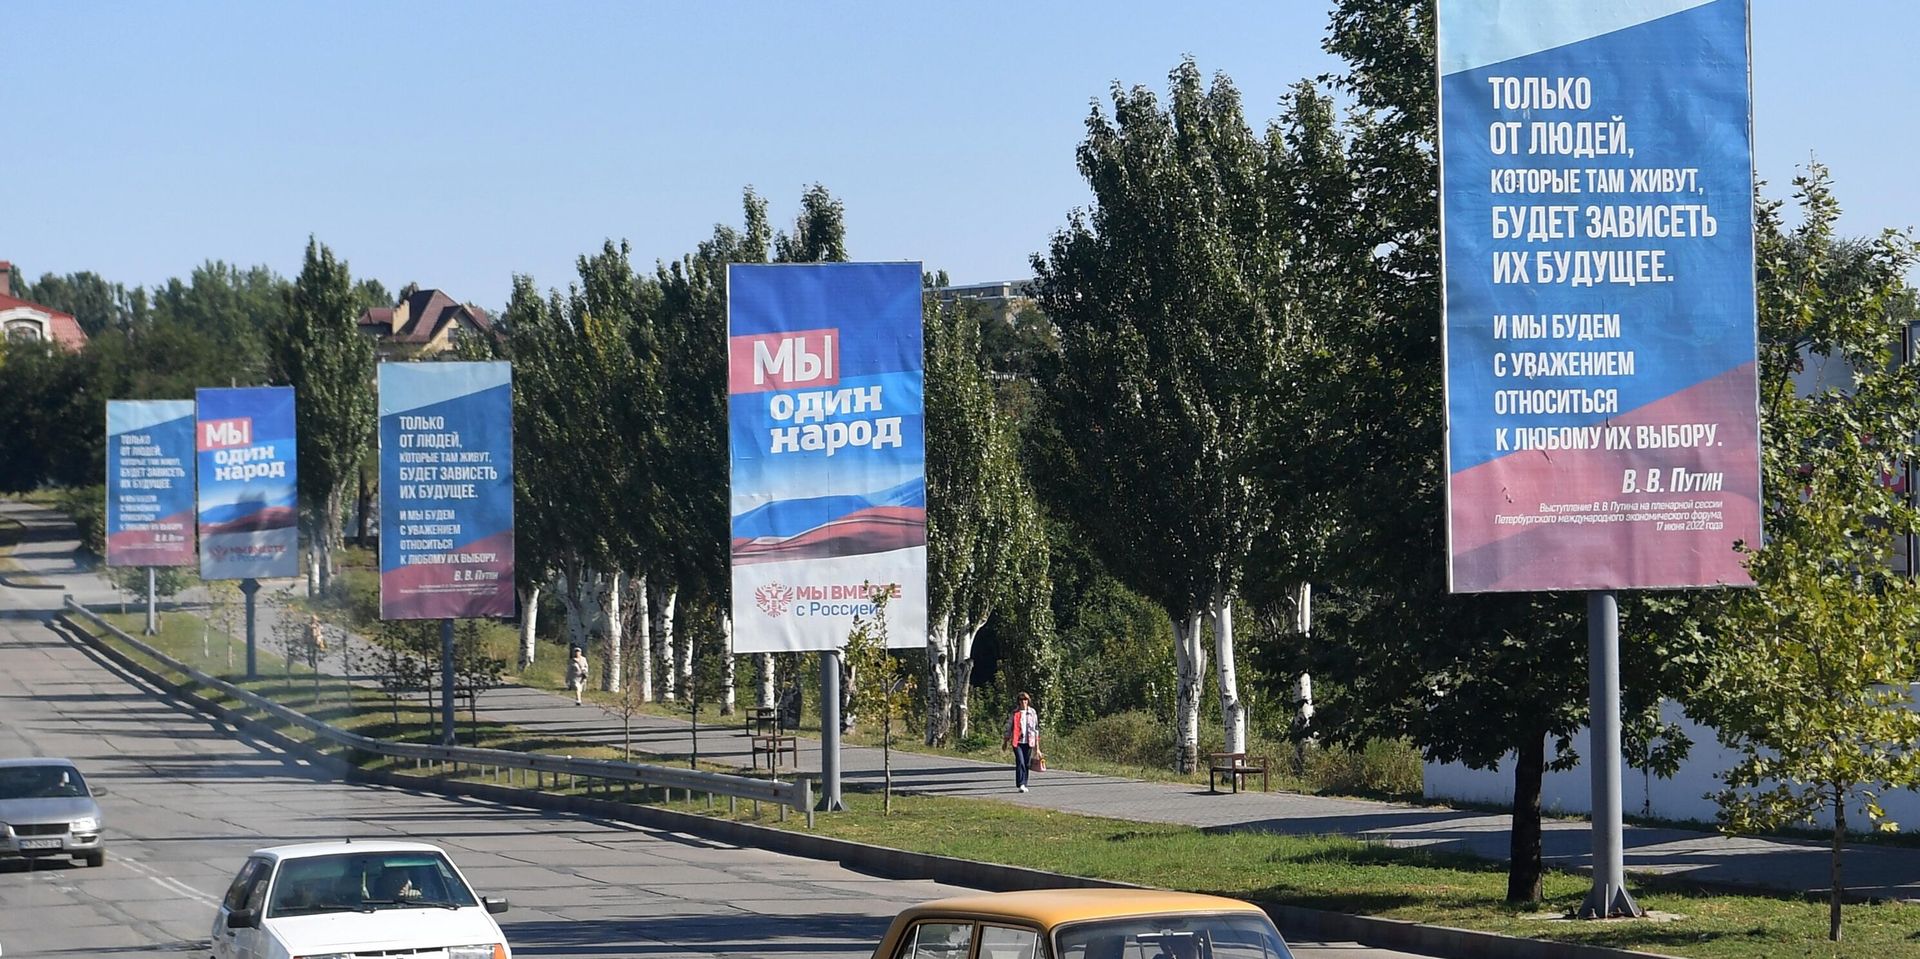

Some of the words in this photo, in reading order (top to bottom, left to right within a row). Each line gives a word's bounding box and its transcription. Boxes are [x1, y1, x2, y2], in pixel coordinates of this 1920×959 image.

[1488, 76, 1591, 110] ТОЛЬКО
[1489, 122, 1521, 155] ОТ
[1528, 115, 1635, 159] ЛЮДЕЙ,
[1491, 169, 1581, 193] КОТОРЫЕ
[1585, 169, 1625, 193] ТАМ
[1629, 168, 1704, 195] ЖИВУТ,
[1492, 206, 1578, 242] БУДЕТ
[1585, 205, 1717, 238] ЗАВИСЕТЬ
[1492, 251, 1530, 284] ИХ
[1536, 250, 1674, 287] БУДУЩЕЕ.
[1493, 315, 1507, 339] И
[1512, 315, 1546, 339] МЫ
[1552, 314, 1621, 340] БУДЕМ
[753, 335, 832, 385] МЫ
[1494, 353, 1506, 377] С
[1511, 351, 1635, 377] УВАЖЕНИЕМ
[770, 386, 882, 424] один
[1495, 389, 1618, 414] ОТНОСИТЬСЯ
[399, 416, 444, 431] ТОЛЬКО
[399, 434, 413, 448] ОТ
[771, 416, 903, 457] народ
[1496, 428, 1510, 451] К
[1513, 427, 1601, 451] ЛЮБОМУ
[1605, 425, 1632, 450] ИХ
[1636, 424, 1723, 449] ВЫБОРУ.
[214, 446, 275, 465] один
[400, 452, 438, 463] КОТОРЫЕ
[440, 452, 458, 463] ТАМ
[215, 460, 285, 482] народ
[400, 467, 437, 482] БУДЕТ
[440, 466, 497, 481] ЗАВИСЕТЬ
[1622, 469, 1640, 493] В.
[1646, 468, 1665, 493] В.
[400, 485, 416, 500] ИХ
[419, 484, 478, 500] БУДУЩЕЕ.
[400, 510, 406, 520] И
[407, 510, 423, 520] МЫ
[425, 509, 455, 521] БУДЕМ
[1540, 503, 1592, 513] Выступление
[1593, 502, 1600, 512] В.
[1602, 502, 1609, 511] В.
[1610, 502, 1638, 512] Путина
[1640, 502, 1649, 510] на
[1651, 500, 1693, 511] пленарной
[1695, 500, 1722, 509] сессии
[1495, 514, 1556, 525] Петербургского
[1558, 515, 1624, 524] международного
[1626, 512, 1689, 521] экономического
[1657, 522, 1663, 531] 17
[1664, 522, 1685, 530] июня
[1686, 521, 1705, 530] 2022
[1706, 521, 1723, 530] года
[400, 525, 406, 535] С
[408, 524, 460, 535] УВАЖЕНИЕМ
[400, 539, 453, 550] ОТНОСИТЬСЯ
[408, 554, 446, 564] ЛЮБОМУ
[448, 554, 459, 563] ИХ
[796, 586, 827, 600] МЫ
